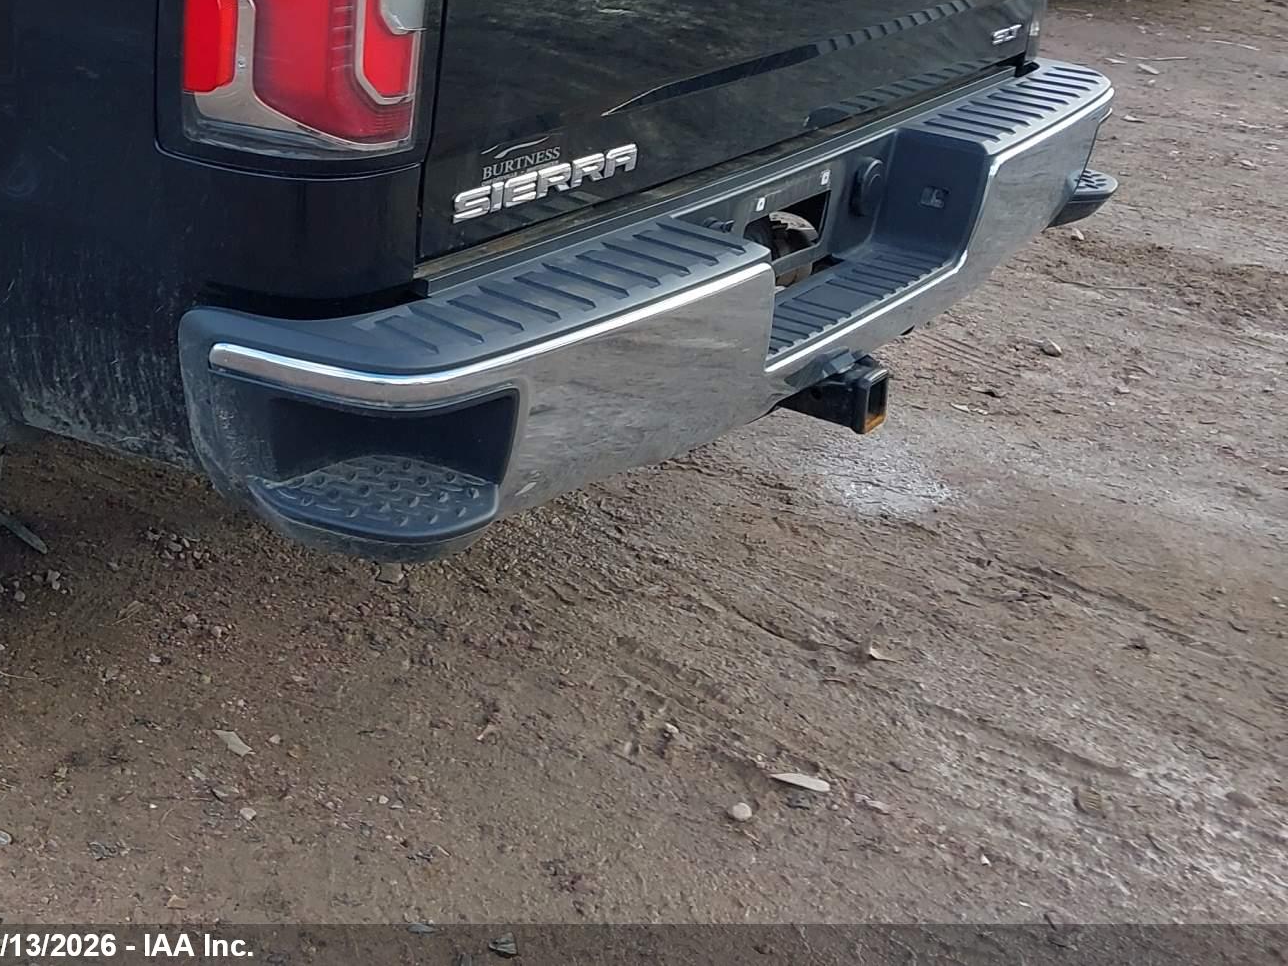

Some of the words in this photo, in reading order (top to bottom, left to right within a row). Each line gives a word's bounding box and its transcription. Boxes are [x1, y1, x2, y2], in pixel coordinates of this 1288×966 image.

[991, 24, 1022, 46] SLT
[482, 146, 560, 180] BURTNESS
[452, 143, 638, 224] SIERRA
